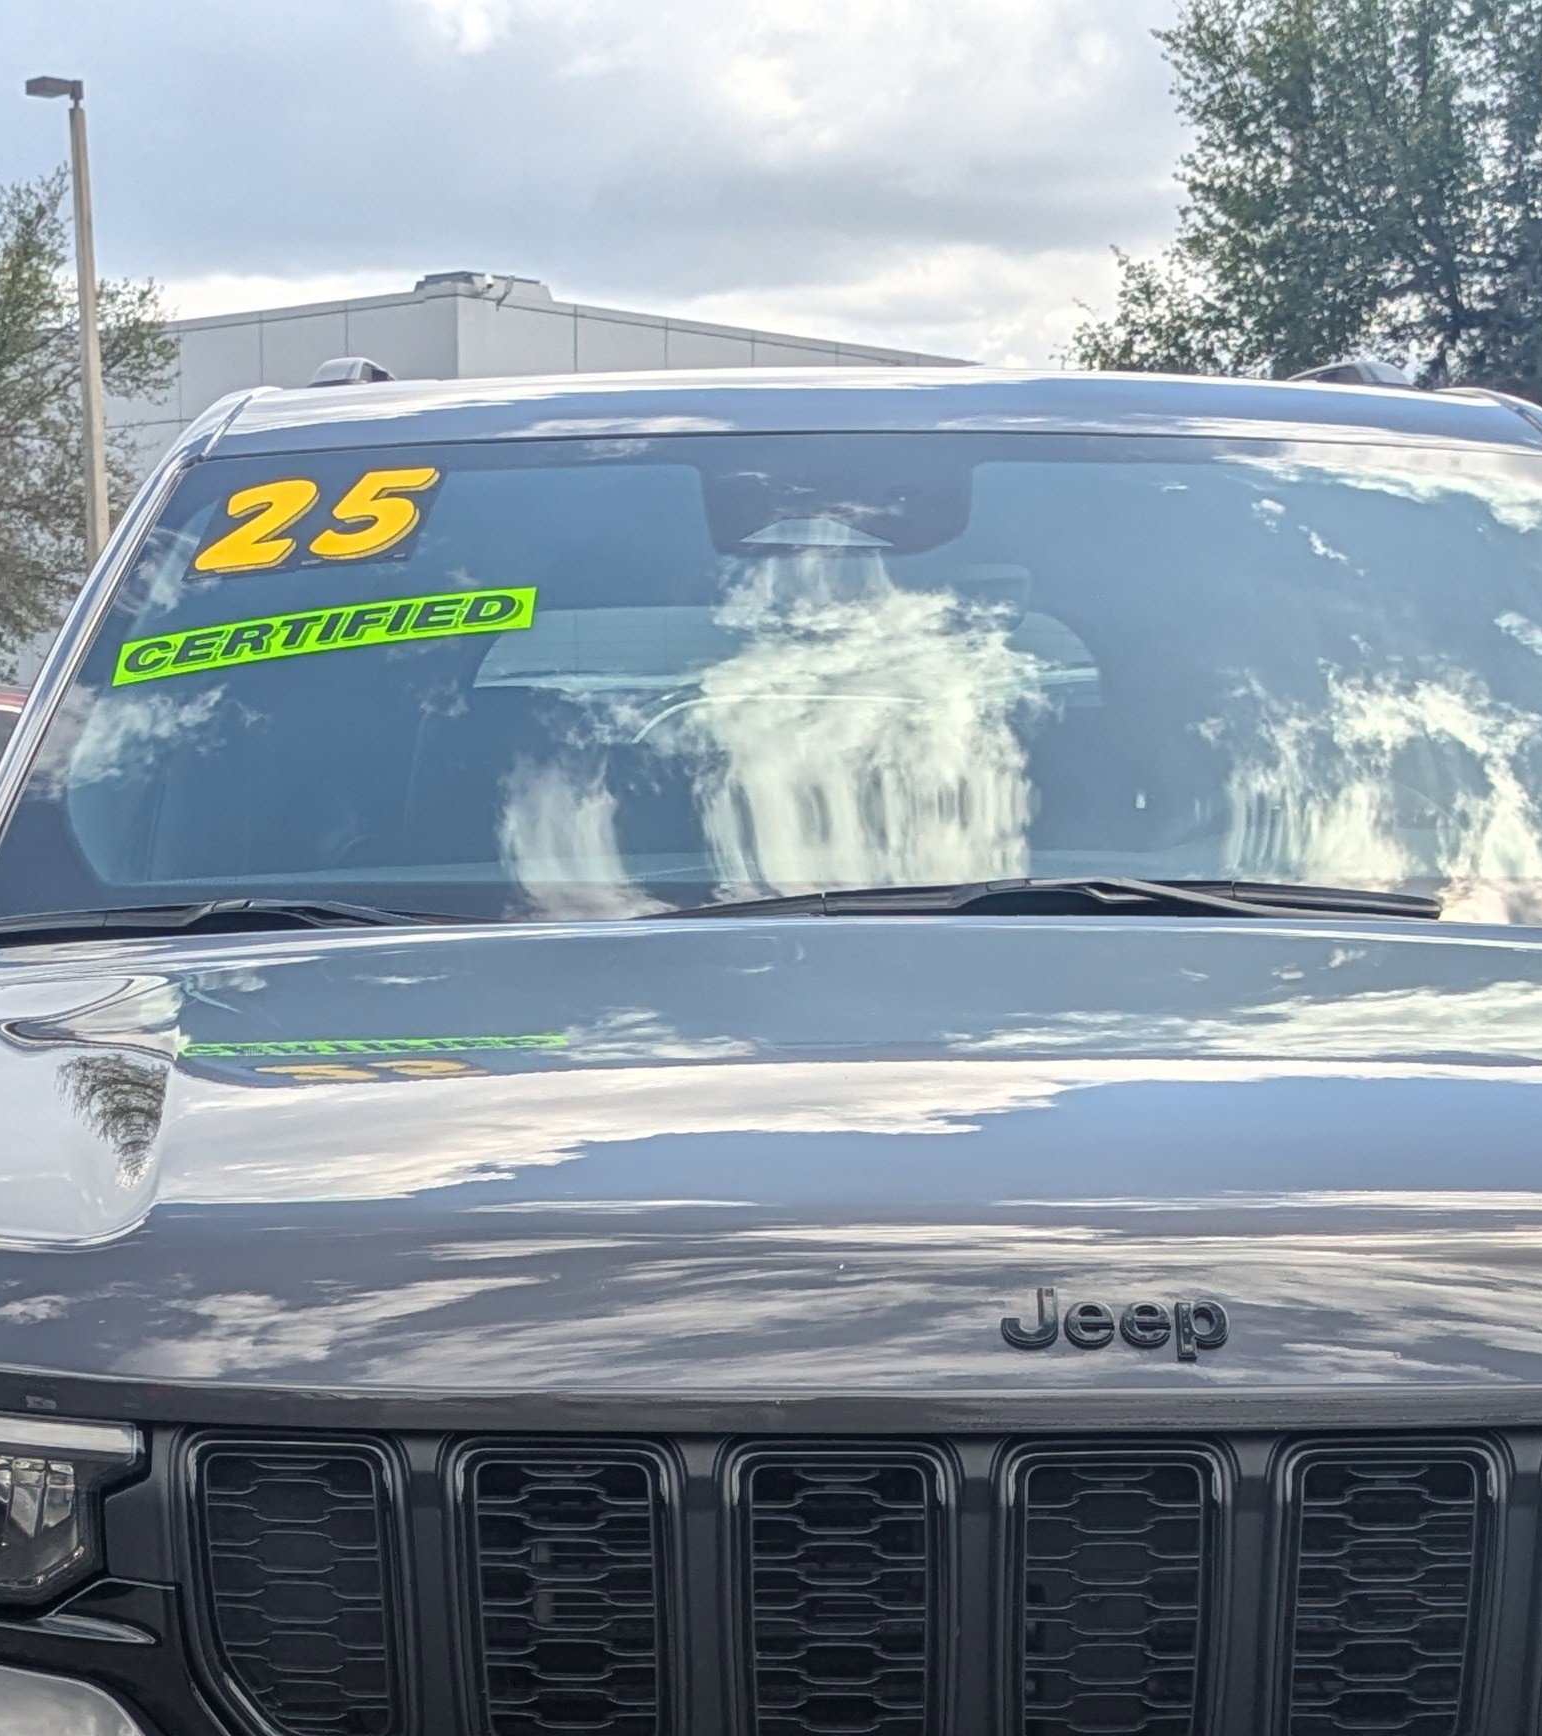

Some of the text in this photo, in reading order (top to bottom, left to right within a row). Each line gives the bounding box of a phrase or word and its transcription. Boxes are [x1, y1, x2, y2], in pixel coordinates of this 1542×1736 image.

[194, 466, 441, 574] 25
[123, 594, 524, 674] CERTIFIED
[1000, 1286, 1230, 1363] Jeep
